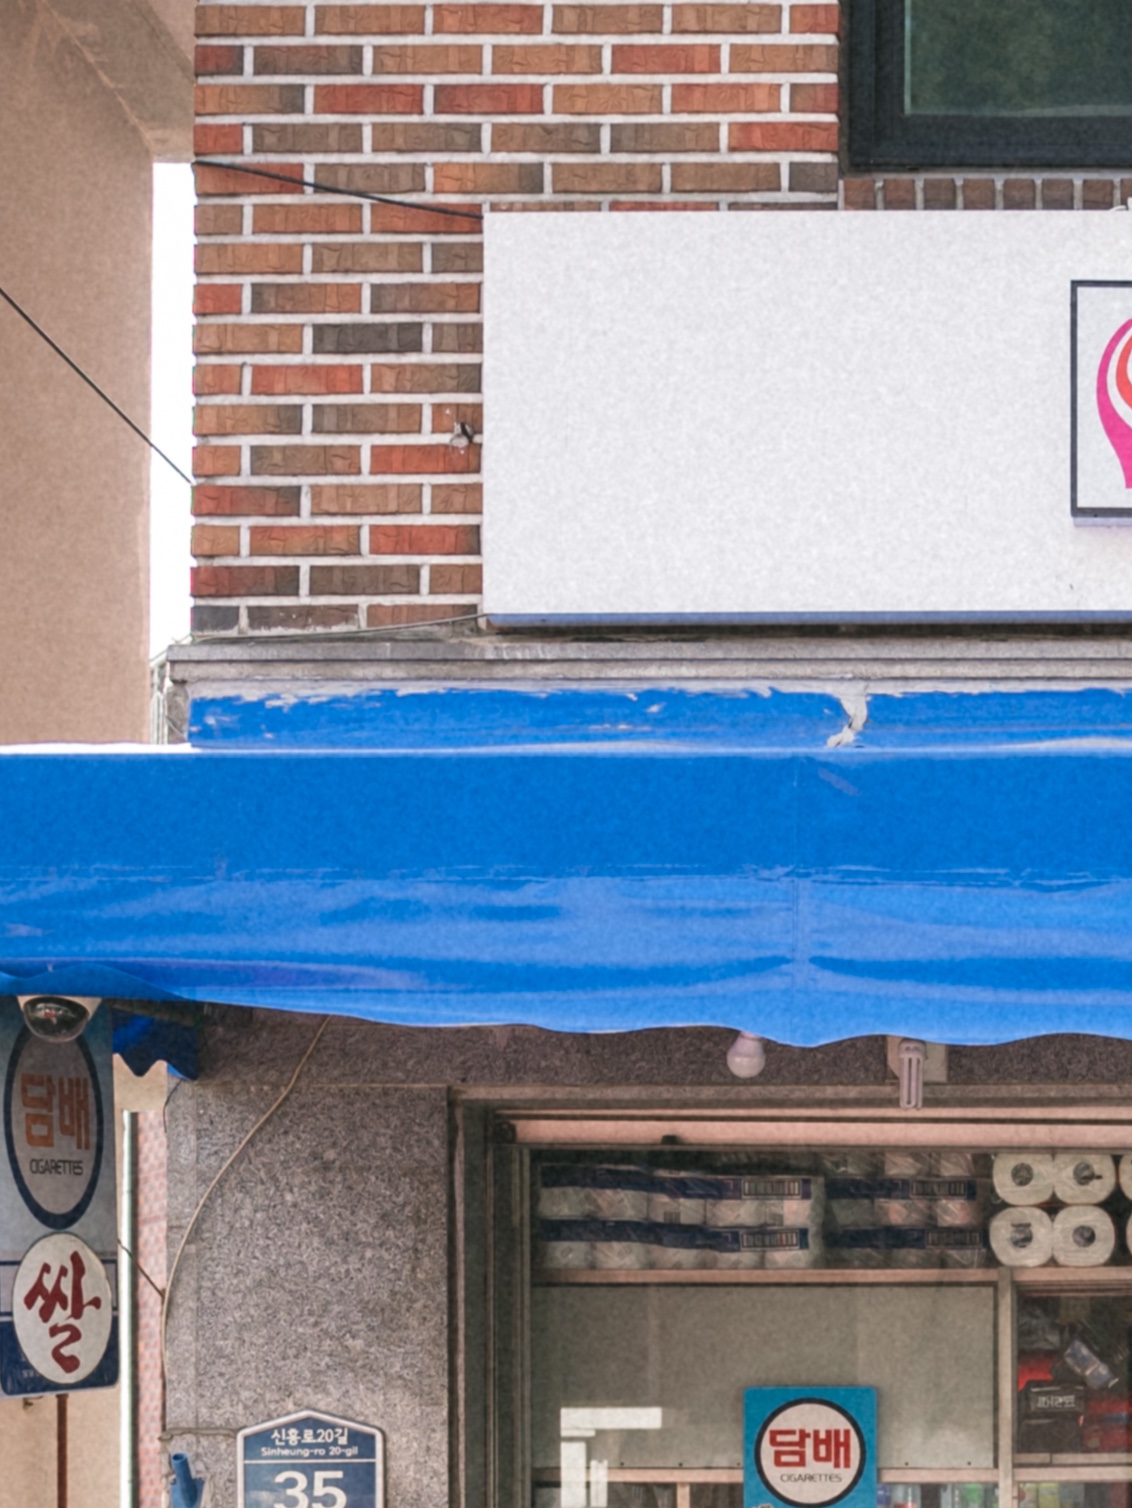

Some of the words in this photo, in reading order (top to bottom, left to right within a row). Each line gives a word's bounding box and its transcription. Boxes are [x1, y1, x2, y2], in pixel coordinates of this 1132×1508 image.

[20, 1073, 91, 1150] 담배
[29, 1158, 84, 1176] CIGARETTES
[24, 1250, 102, 1374] 쌀
[271, 1428, 349, 1446] 신흥로20길
[261, 1447, 326, 1457] Sinheung-ro
[329, 1446, 359, 1457] 20-gil
[768, 1428, 852, 1469] 담배
[779, 1473, 843, 1483] CIGARETTES
